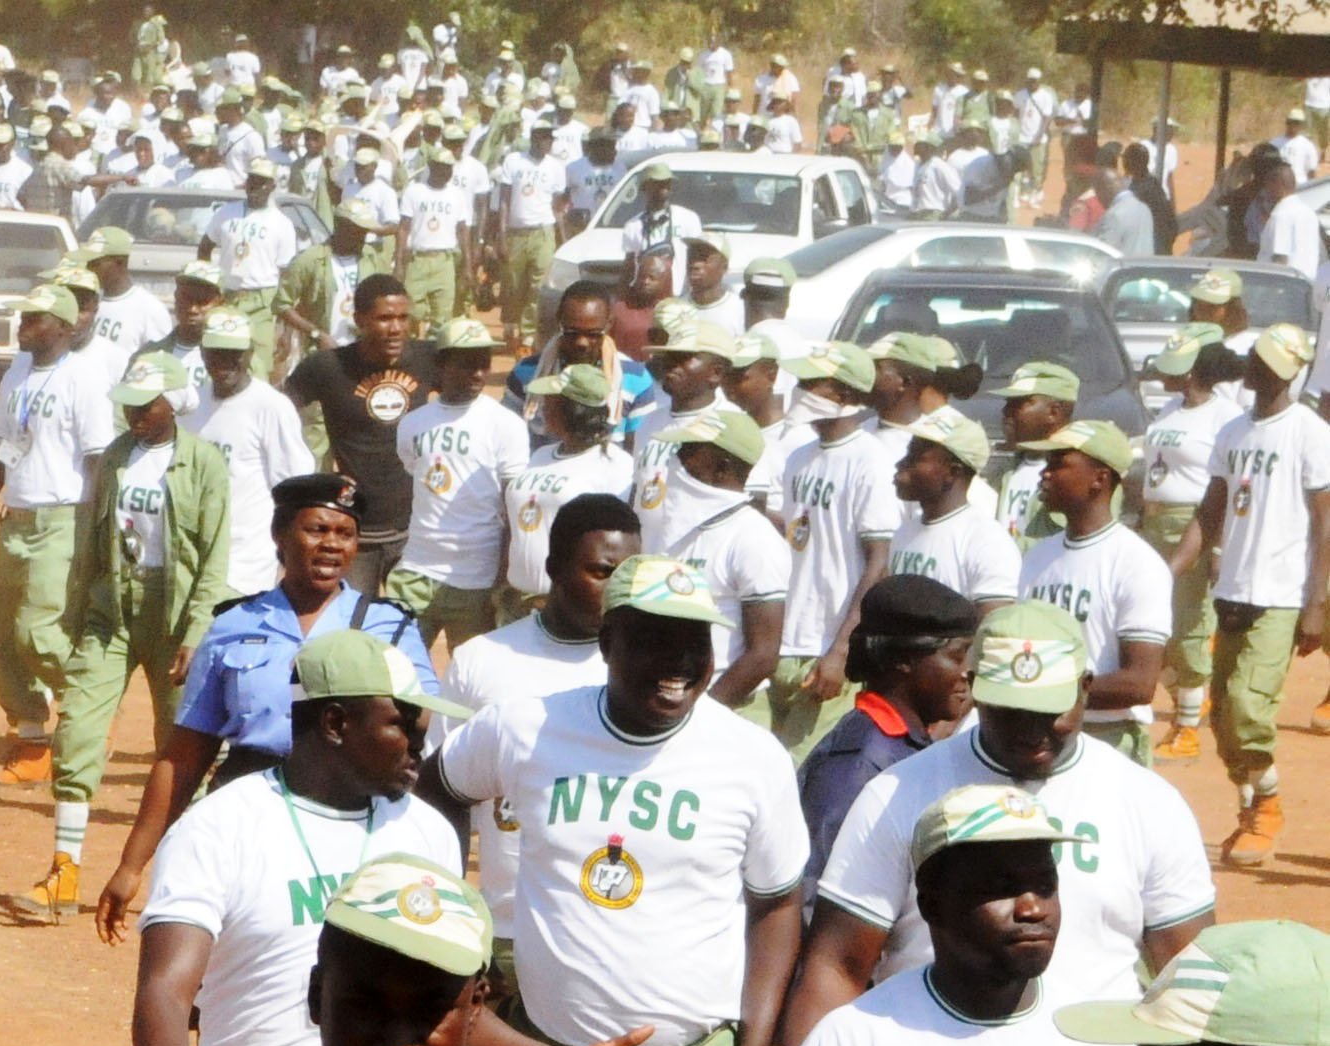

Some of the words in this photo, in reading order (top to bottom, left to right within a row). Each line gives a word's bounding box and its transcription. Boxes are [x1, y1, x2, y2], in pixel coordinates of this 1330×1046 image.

[453, 176, 467, 187] SC
[420, 201, 451, 215] NYSC
[413, 426, 470, 458] NYSC
[639, 440, 679, 468] NYS
[1229, 449, 1279, 477] NYSC
[509, 472, 568, 494] NYSC
[791, 476, 834, 511] NYSC
[118, 485, 161, 515] YSC
[1008, 489, 1029, 515] YS
[548, 774, 701, 842] NYSC
